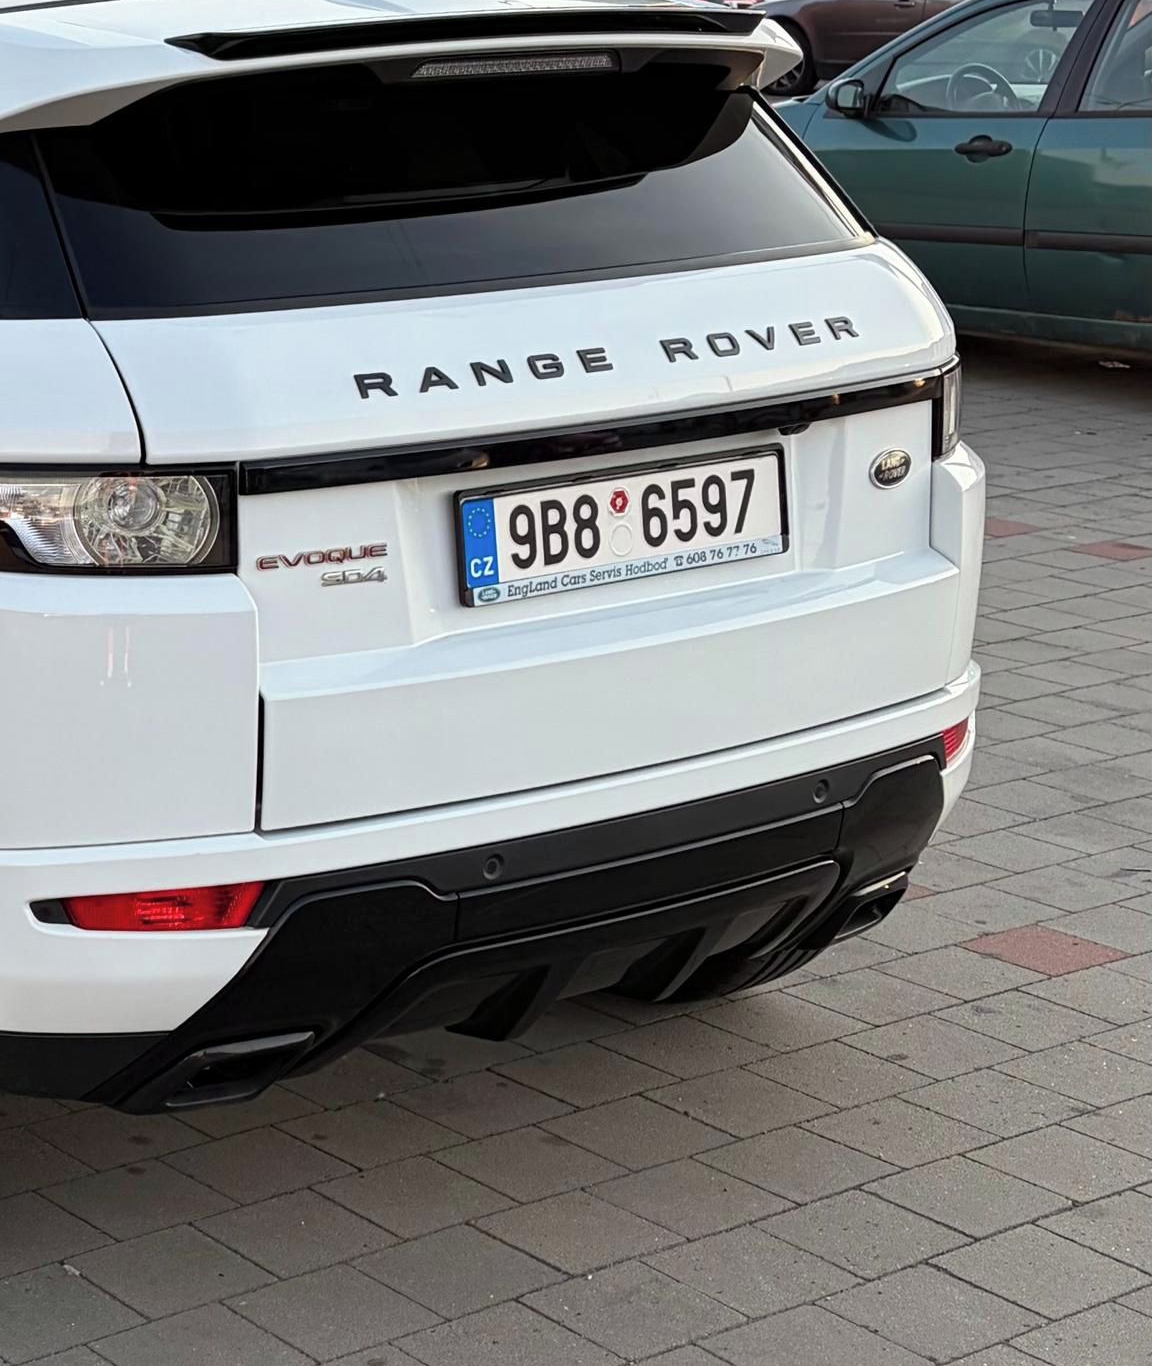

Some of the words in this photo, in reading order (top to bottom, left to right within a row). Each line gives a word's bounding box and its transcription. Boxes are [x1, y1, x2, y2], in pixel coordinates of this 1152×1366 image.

[353, 346, 614, 399] RANGE
[659, 315, 860, 363] ROVER
[508, 493, 600, 570] 9B8
[640, 468, 755, 548] 6597
[256, 542, 388, 572] EVOQUE
[470, 556, 494, 578] CZ
[561, 573, 587, 587] Cars
[589, 565, 622, 583] Servis
[686, 550, 707, 565] 608
[710, 547, 724, 561] 76
[726, 545, 740, 558] 77
[743, 542, 757, 555] 76
[320, 566, 388, 587] SD4
